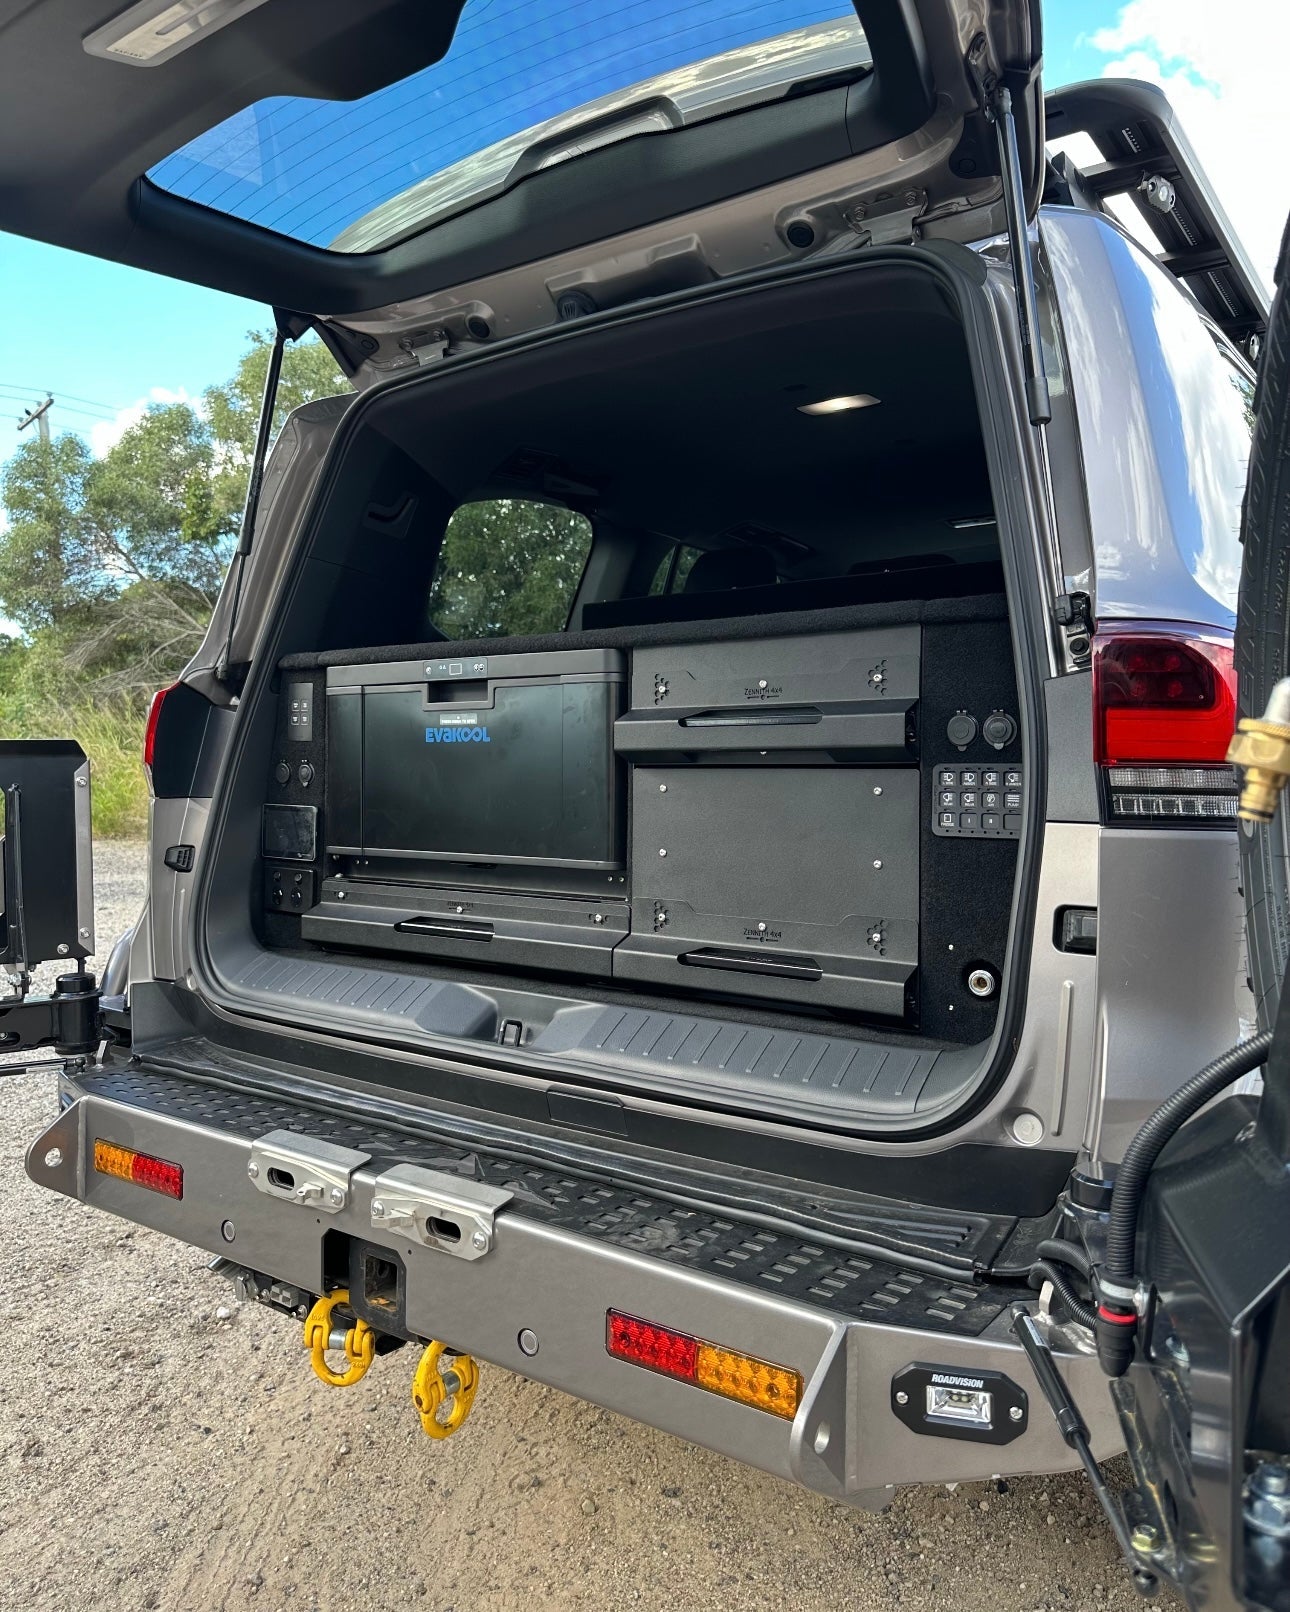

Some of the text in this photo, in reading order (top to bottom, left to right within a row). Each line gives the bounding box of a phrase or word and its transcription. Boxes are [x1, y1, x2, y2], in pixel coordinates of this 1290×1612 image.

[744, 687, 770, 696] ZENNITH
[743, 928, 769, 937] ZENNITH
[931, 1373, 984, 1389] ROADVISION
